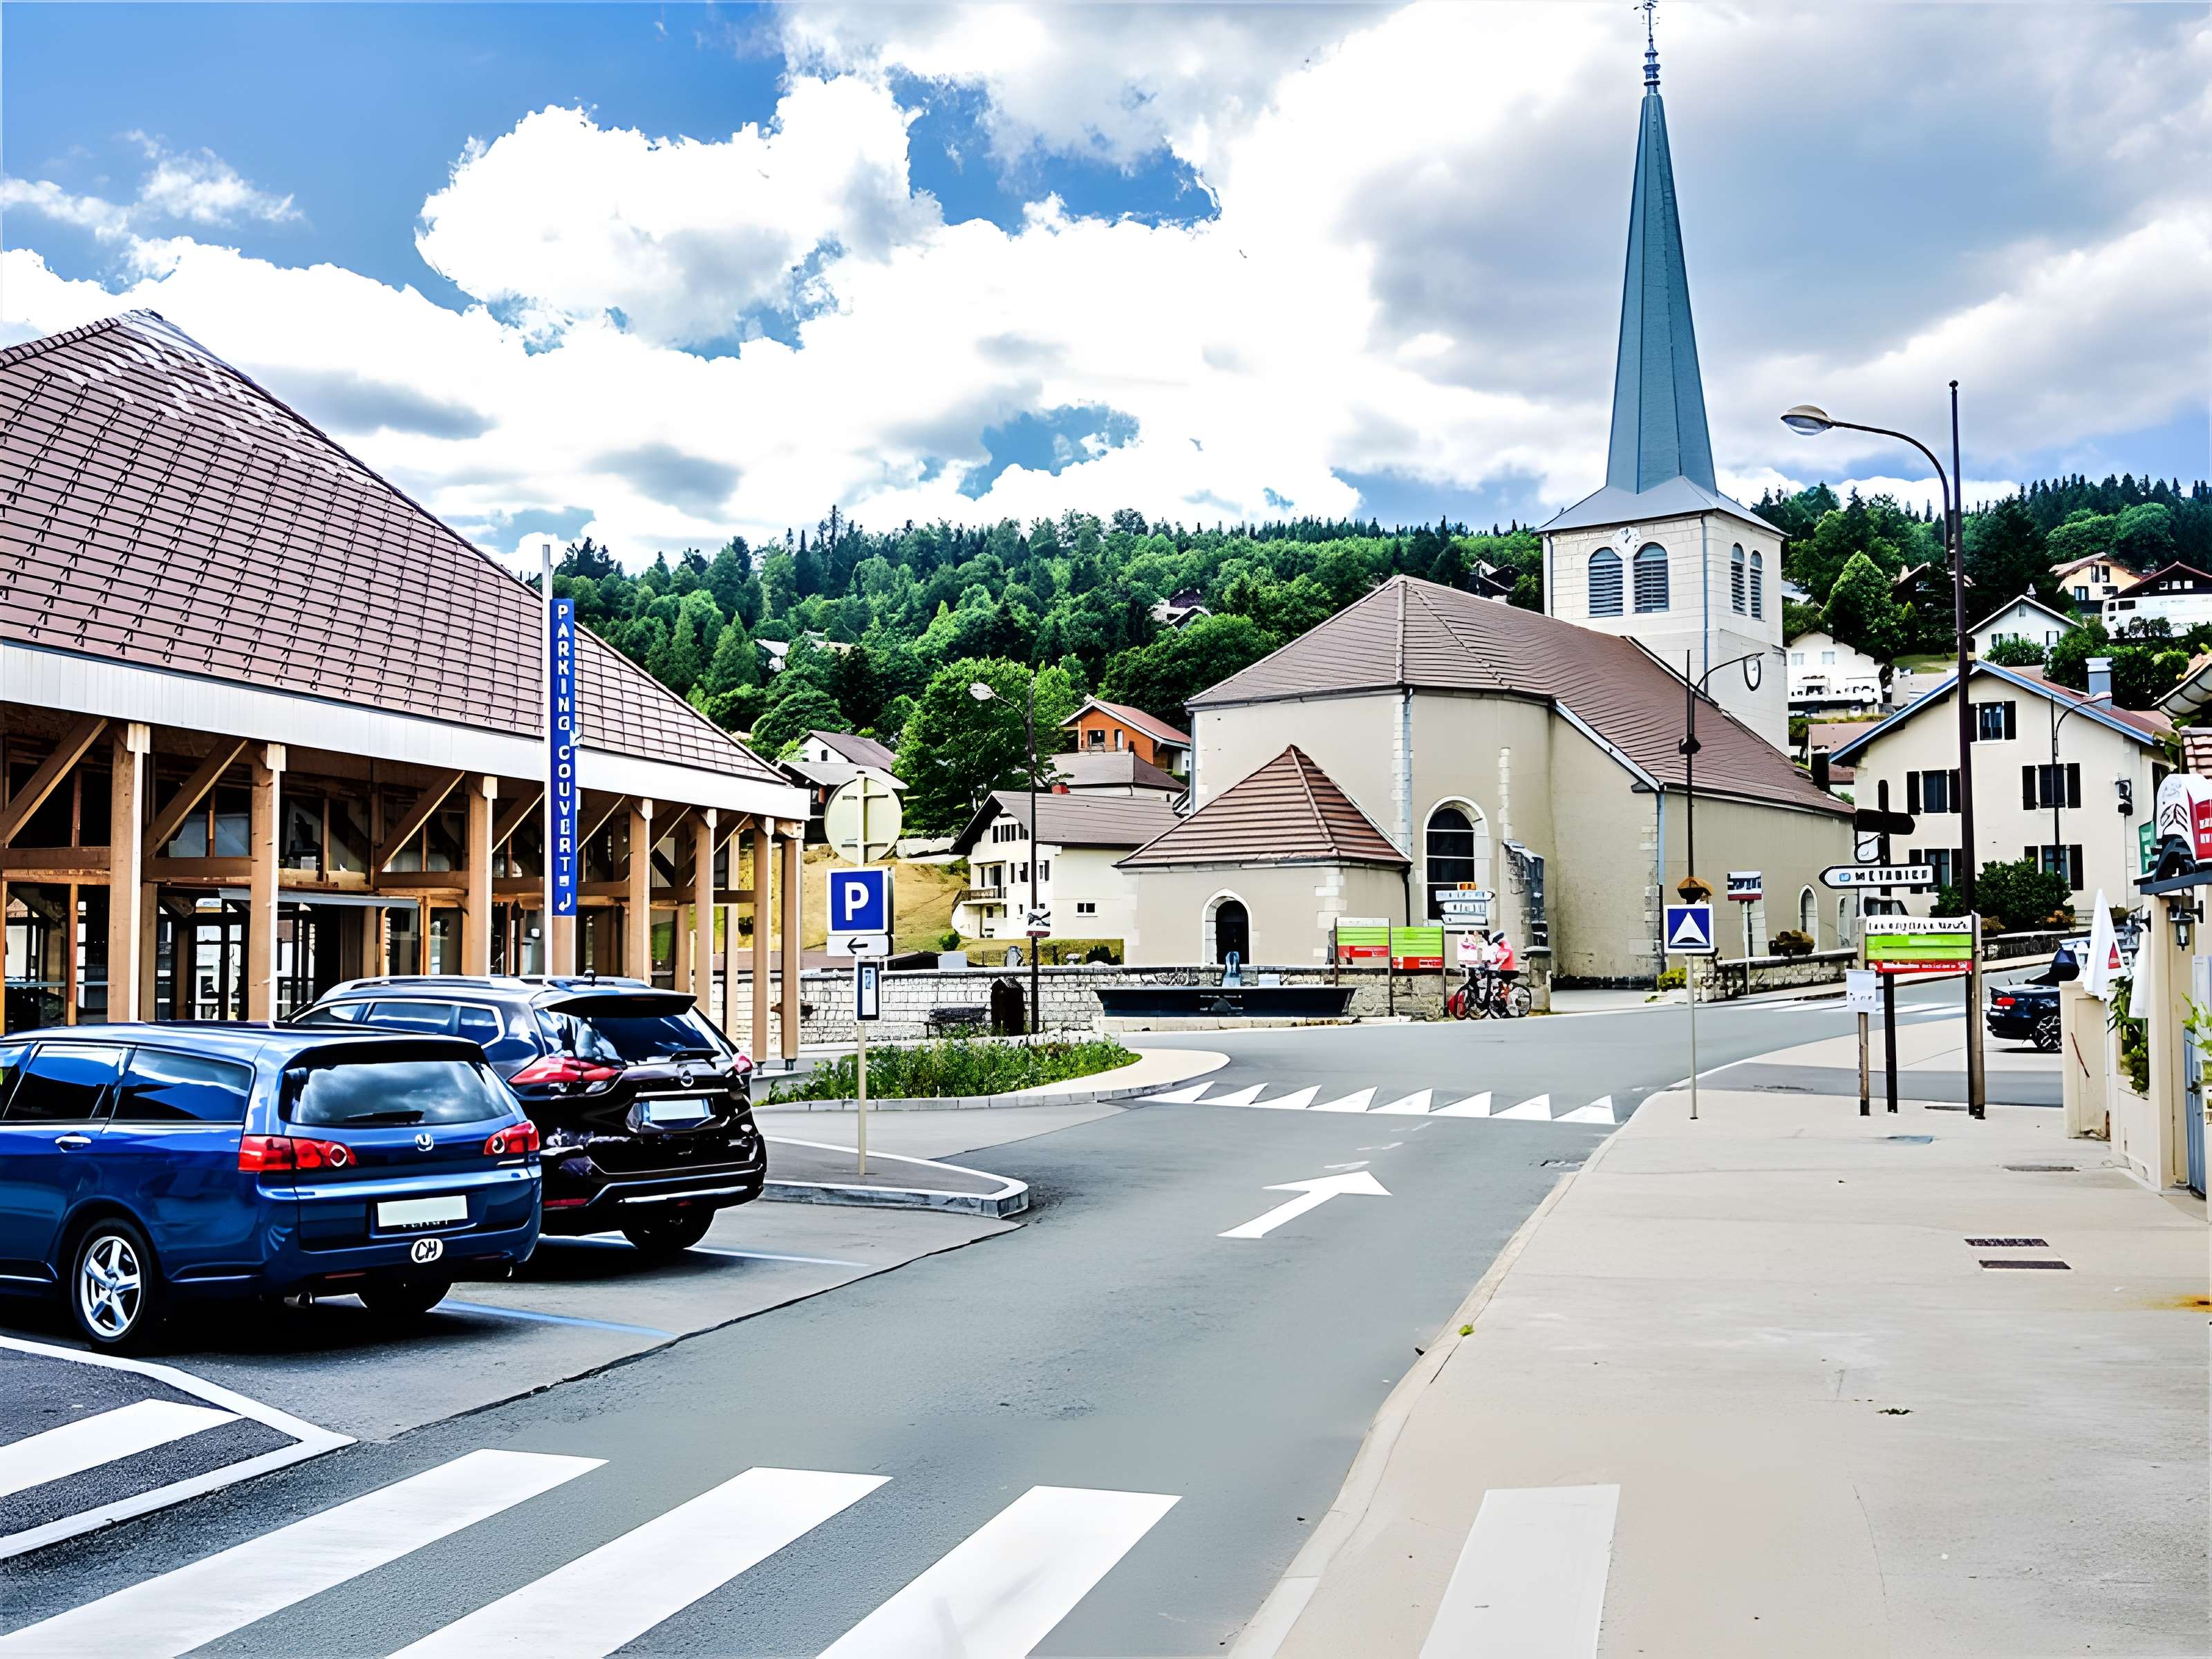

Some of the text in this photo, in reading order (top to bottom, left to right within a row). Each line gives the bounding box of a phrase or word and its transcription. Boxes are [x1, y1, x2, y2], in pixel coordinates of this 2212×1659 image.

[557, 604, 570, 731] PARKING
[845, 882, 869, 921] P
[415, 1241, 438, 1261] CH
